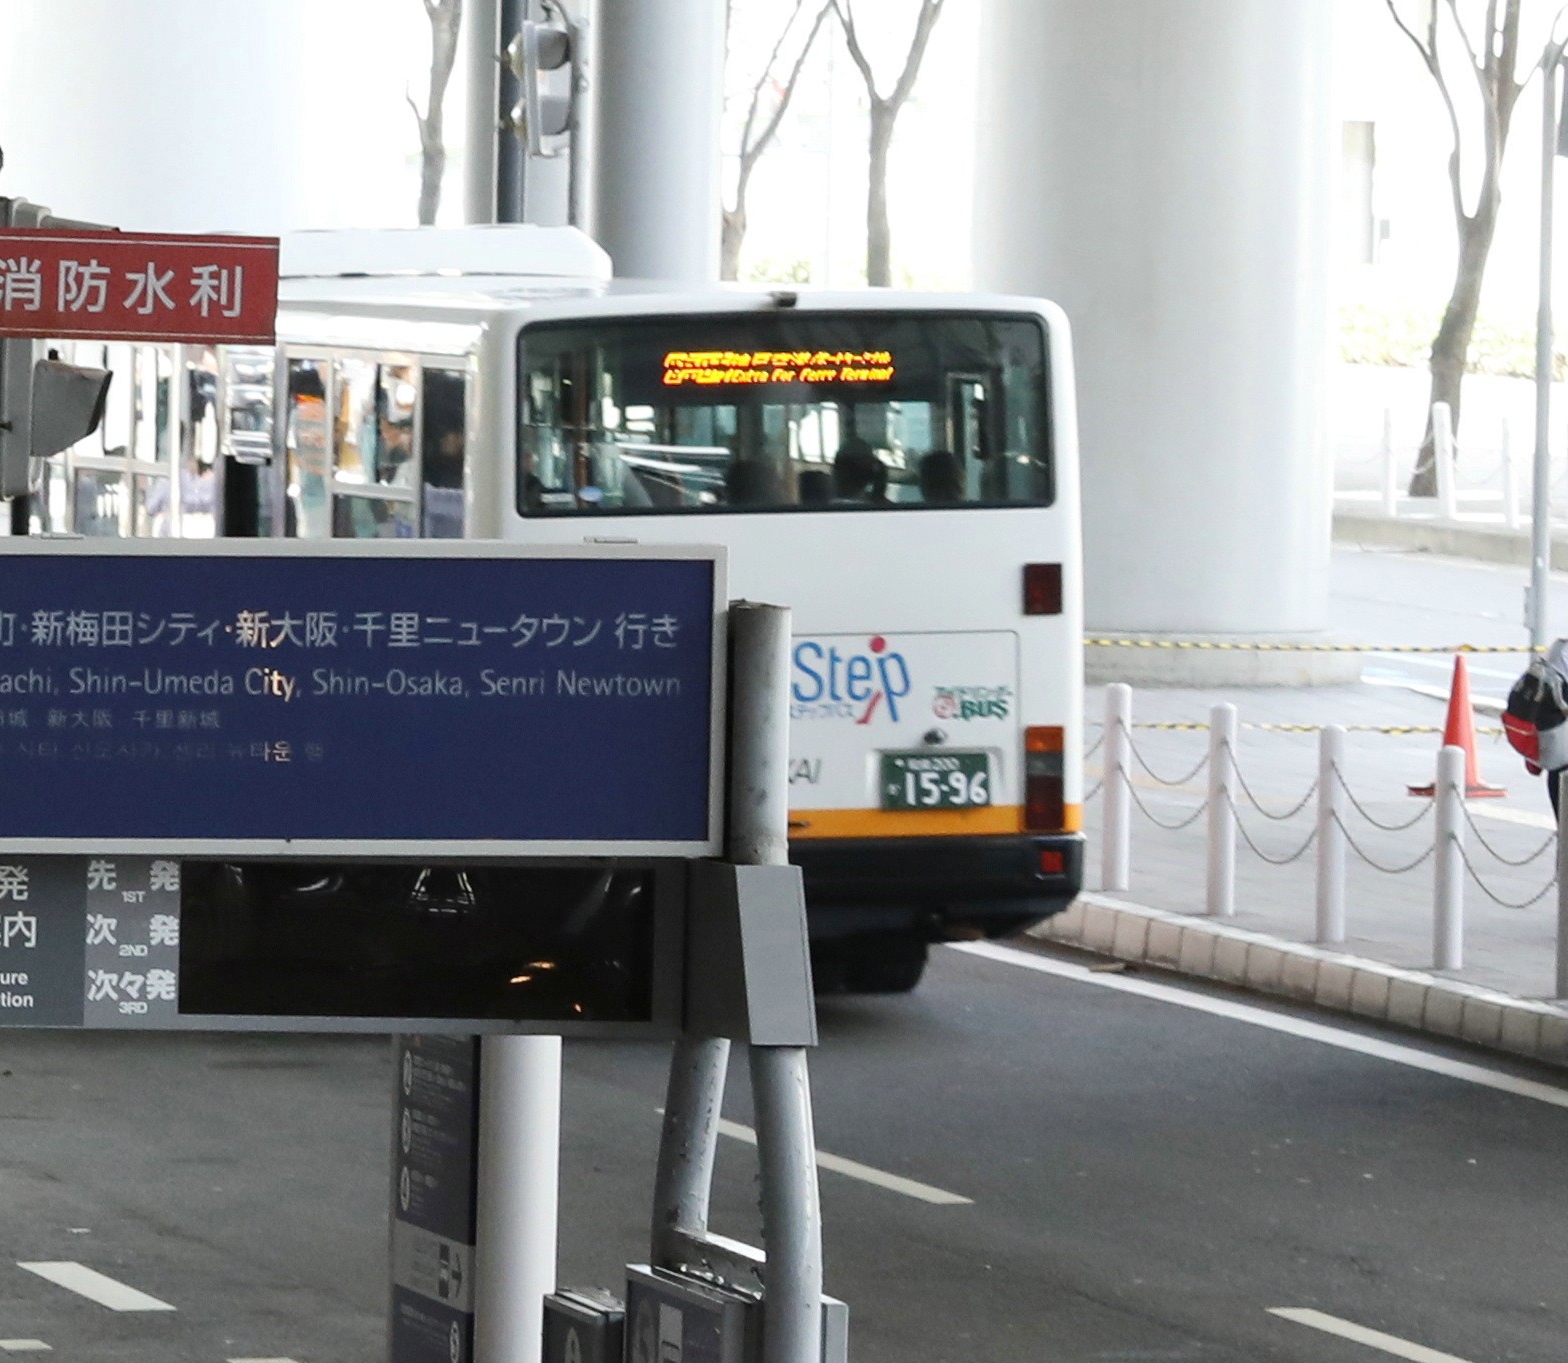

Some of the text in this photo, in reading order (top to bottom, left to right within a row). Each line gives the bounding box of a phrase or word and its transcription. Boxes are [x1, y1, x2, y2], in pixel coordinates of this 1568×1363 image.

[613, 612, 679, 650] 行き
[70, 667, 234, 696] Shin-Umeda
[246, 668, 302, 702] City,
[312, 668, 471, 699] Shin-Osaka,
[480, 669, 546, 697] Senri
[557, 669, 682, 698] Newtown
[791, 640, 911, 722] Step
[905, 770, 988, 806] 15-96
[121, 890, 146, 904] 1ST
[118, 944, 148, 958] 2ND
[86, 968, 177, 1001] 次々発
[118, 1001, 148, 1015] 3RD
